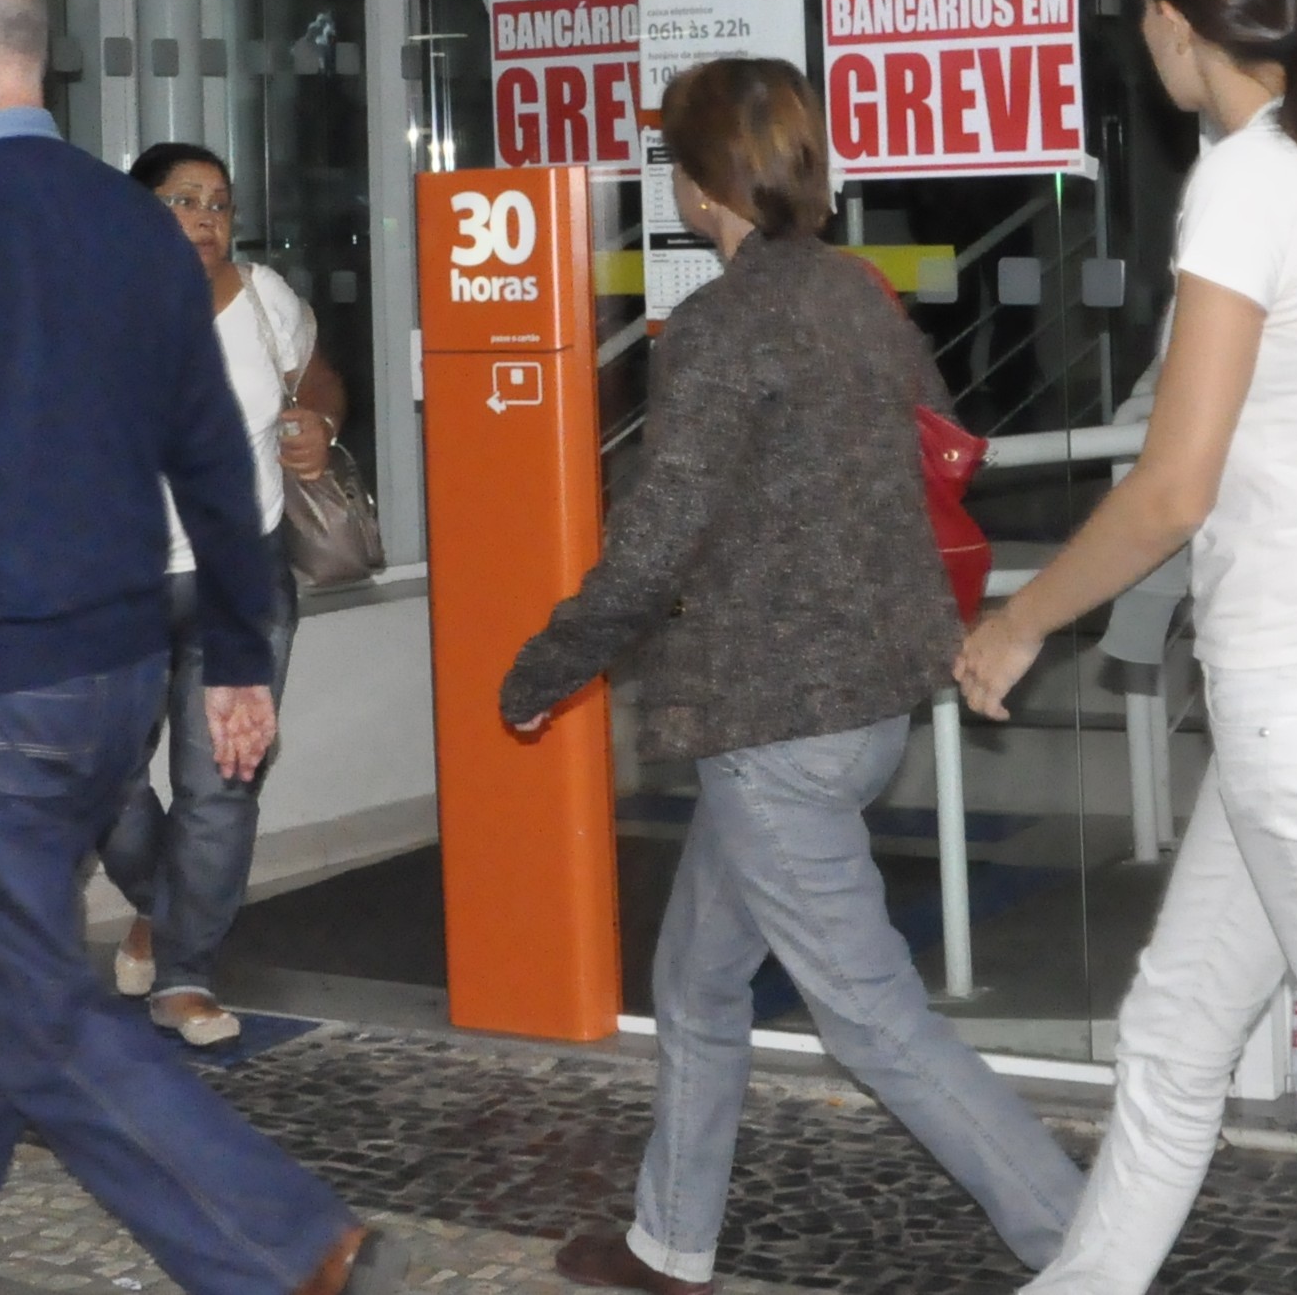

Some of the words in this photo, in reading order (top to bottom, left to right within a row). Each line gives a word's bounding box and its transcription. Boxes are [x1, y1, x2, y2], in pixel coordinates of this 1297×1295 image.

[498, 1, 640, 51] BANCÁRIO
[648, 21, 683, 41] 06h
[689, 19, 709, 39] às
[714, 17, 751, 38] 22h
[496, 62, 641, 168] GRE
[829, 44, 1079, 160] GREVE
[450, 189, 537, 267] 30
[450, 268, 539, 302] horas
